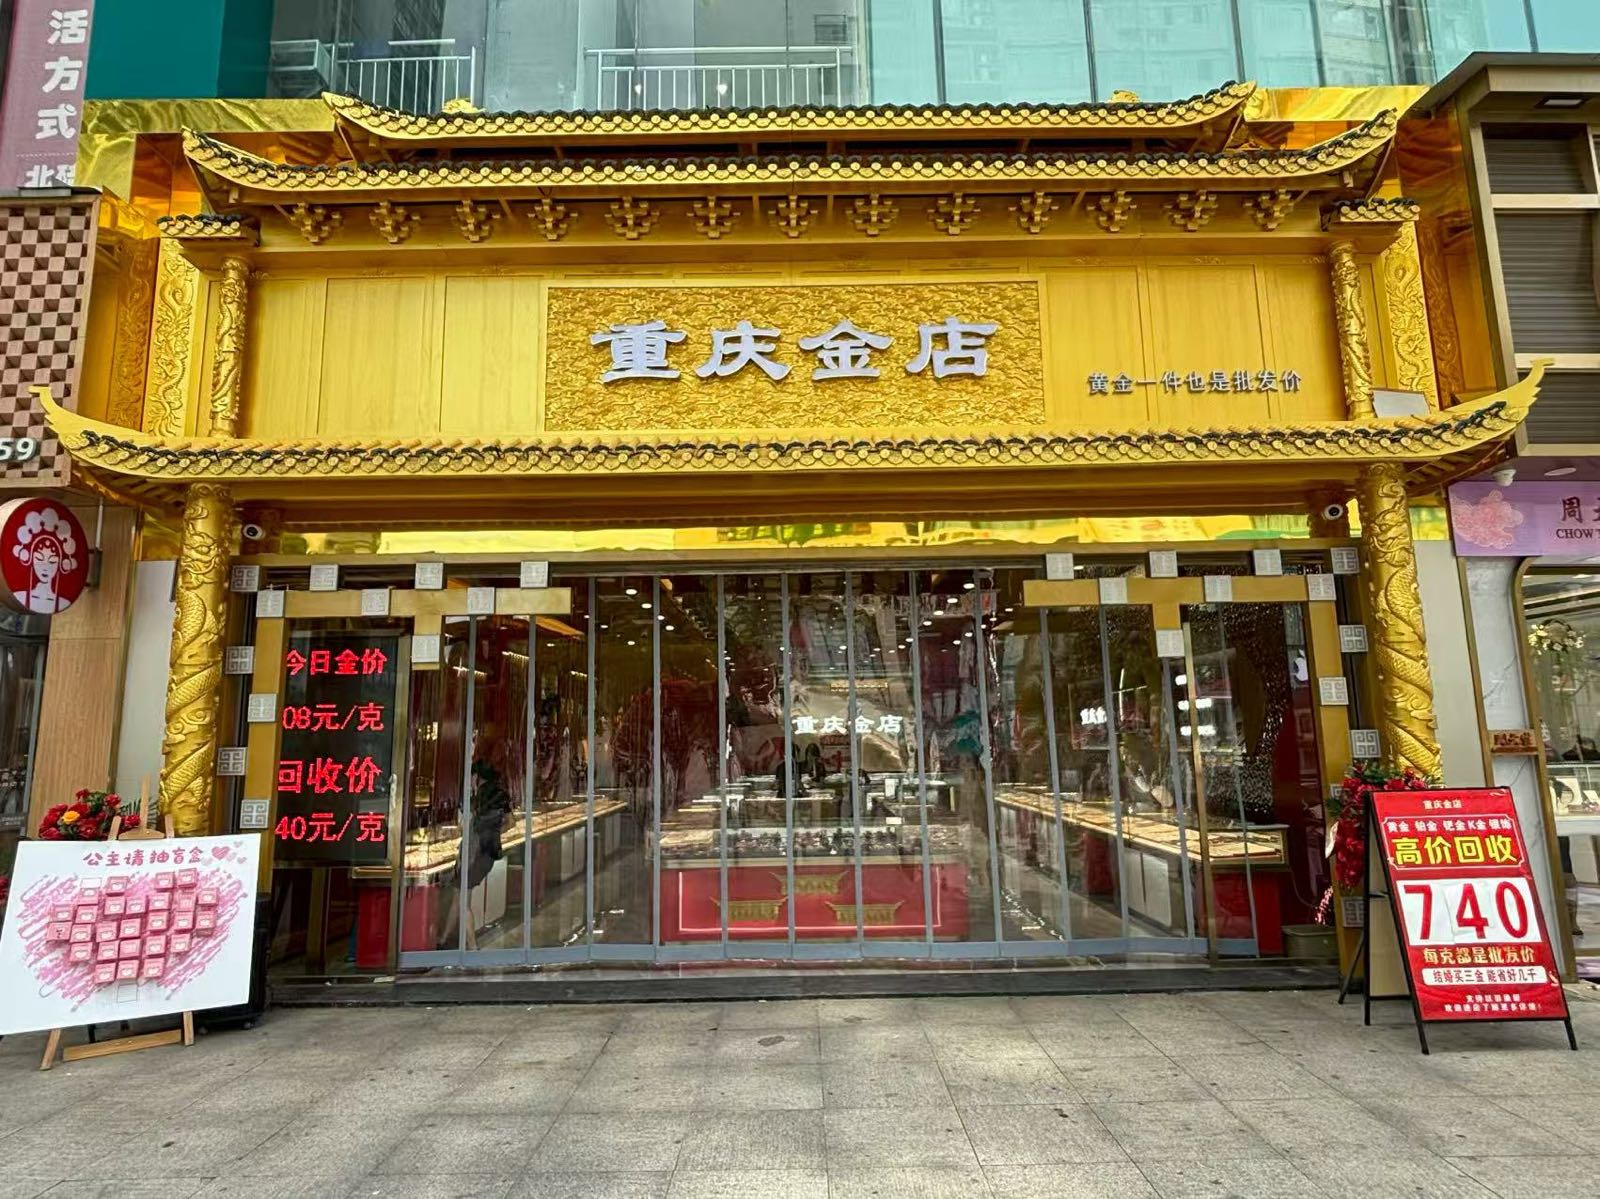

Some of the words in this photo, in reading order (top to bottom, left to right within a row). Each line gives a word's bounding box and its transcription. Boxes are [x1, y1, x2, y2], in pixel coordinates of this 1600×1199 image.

[36, 10, 88, 140] 活方式
[591, 317, 999, 383] 重庆金店
[1088, 370, 1302, 395] 黄金一件也是批发价
[1556, 528, 1593, 539] CHOW
[286, 648, 388, 676] 今日金价
[282, 702, 385, 732] 08元/克
[792, 714, 903, 735] 重庆金店
[277, 757, 384, 793] 回收价
[275, 811, 386, 842] 40元/克
[83, 846, 204, 867] 公主请抽盲盒
[1392, 835, 1518, 865] 高价回收
[1404, 881, 1529, 940] 740
[1423, 946, 1535, 964] 每克都是批发价
